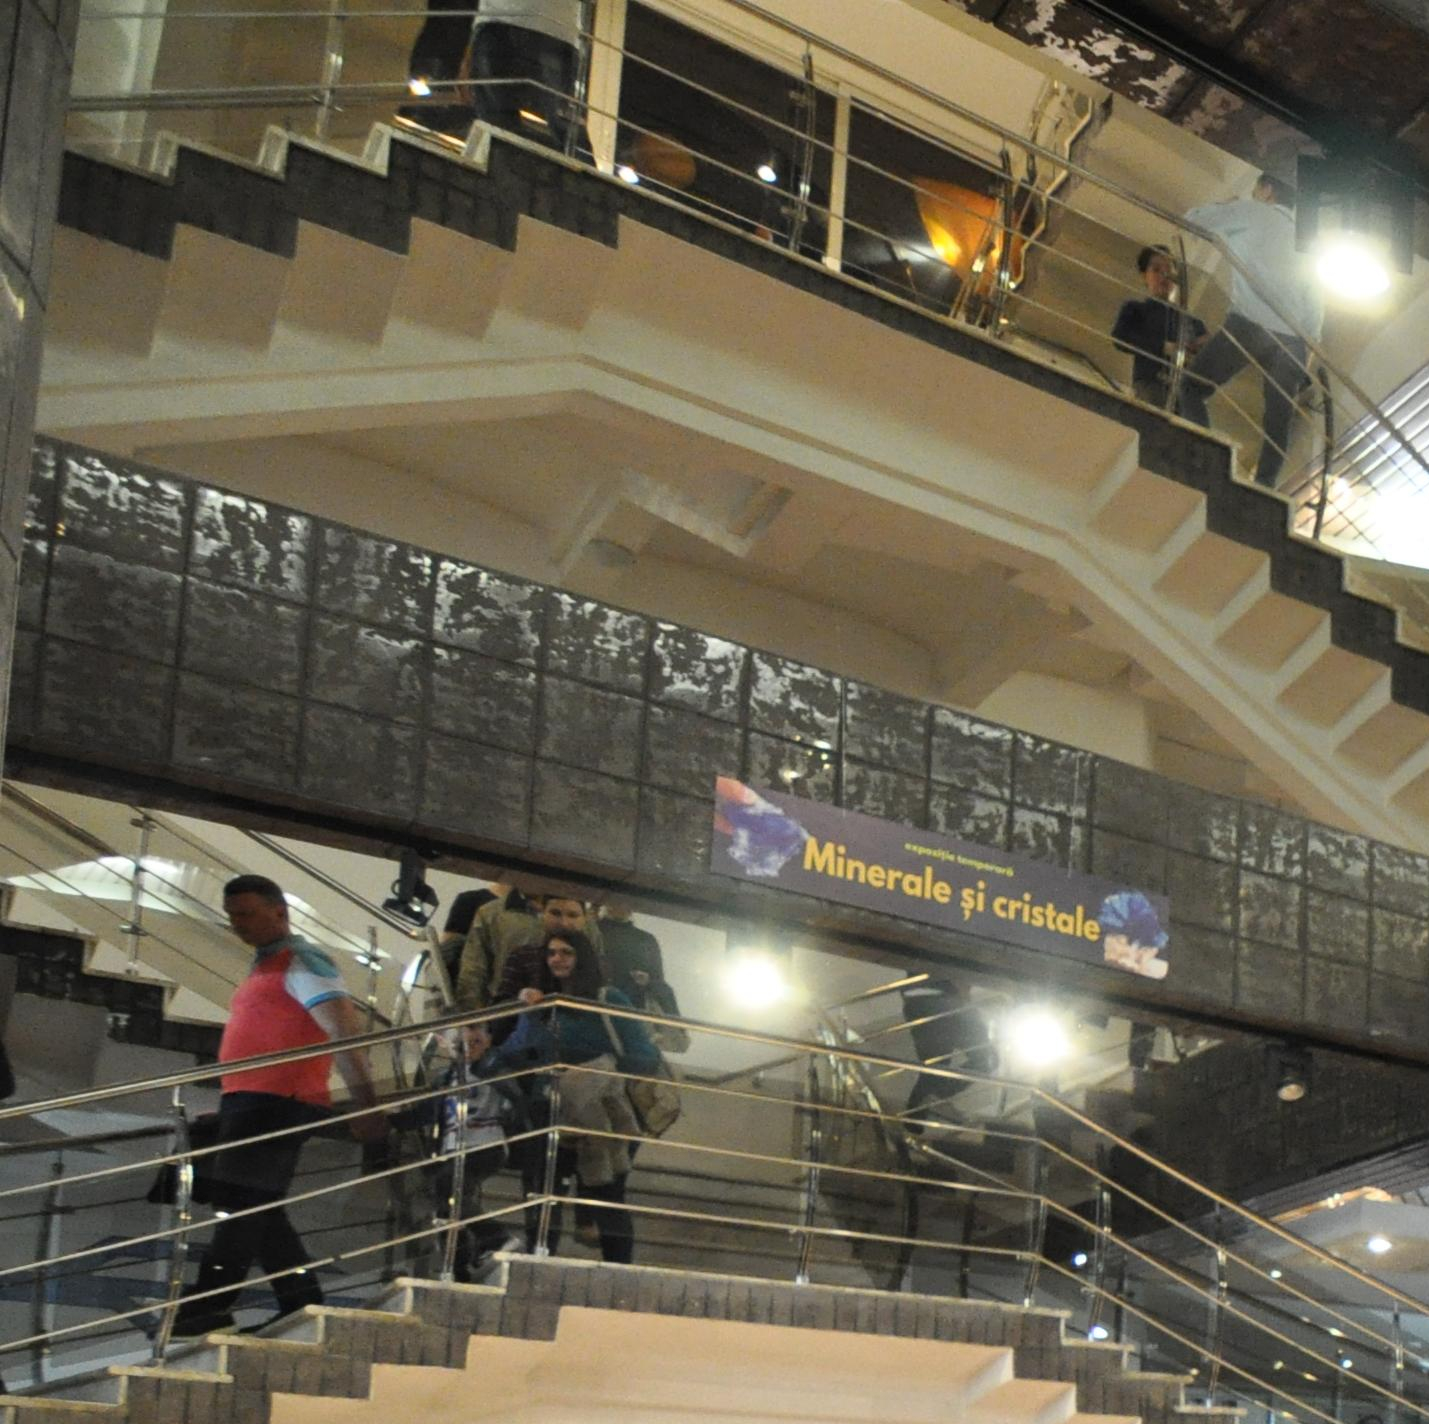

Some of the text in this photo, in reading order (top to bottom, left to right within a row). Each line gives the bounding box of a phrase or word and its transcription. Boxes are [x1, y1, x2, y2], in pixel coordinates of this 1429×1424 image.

[803, 836, 1101, 942] Minerale și cristale
